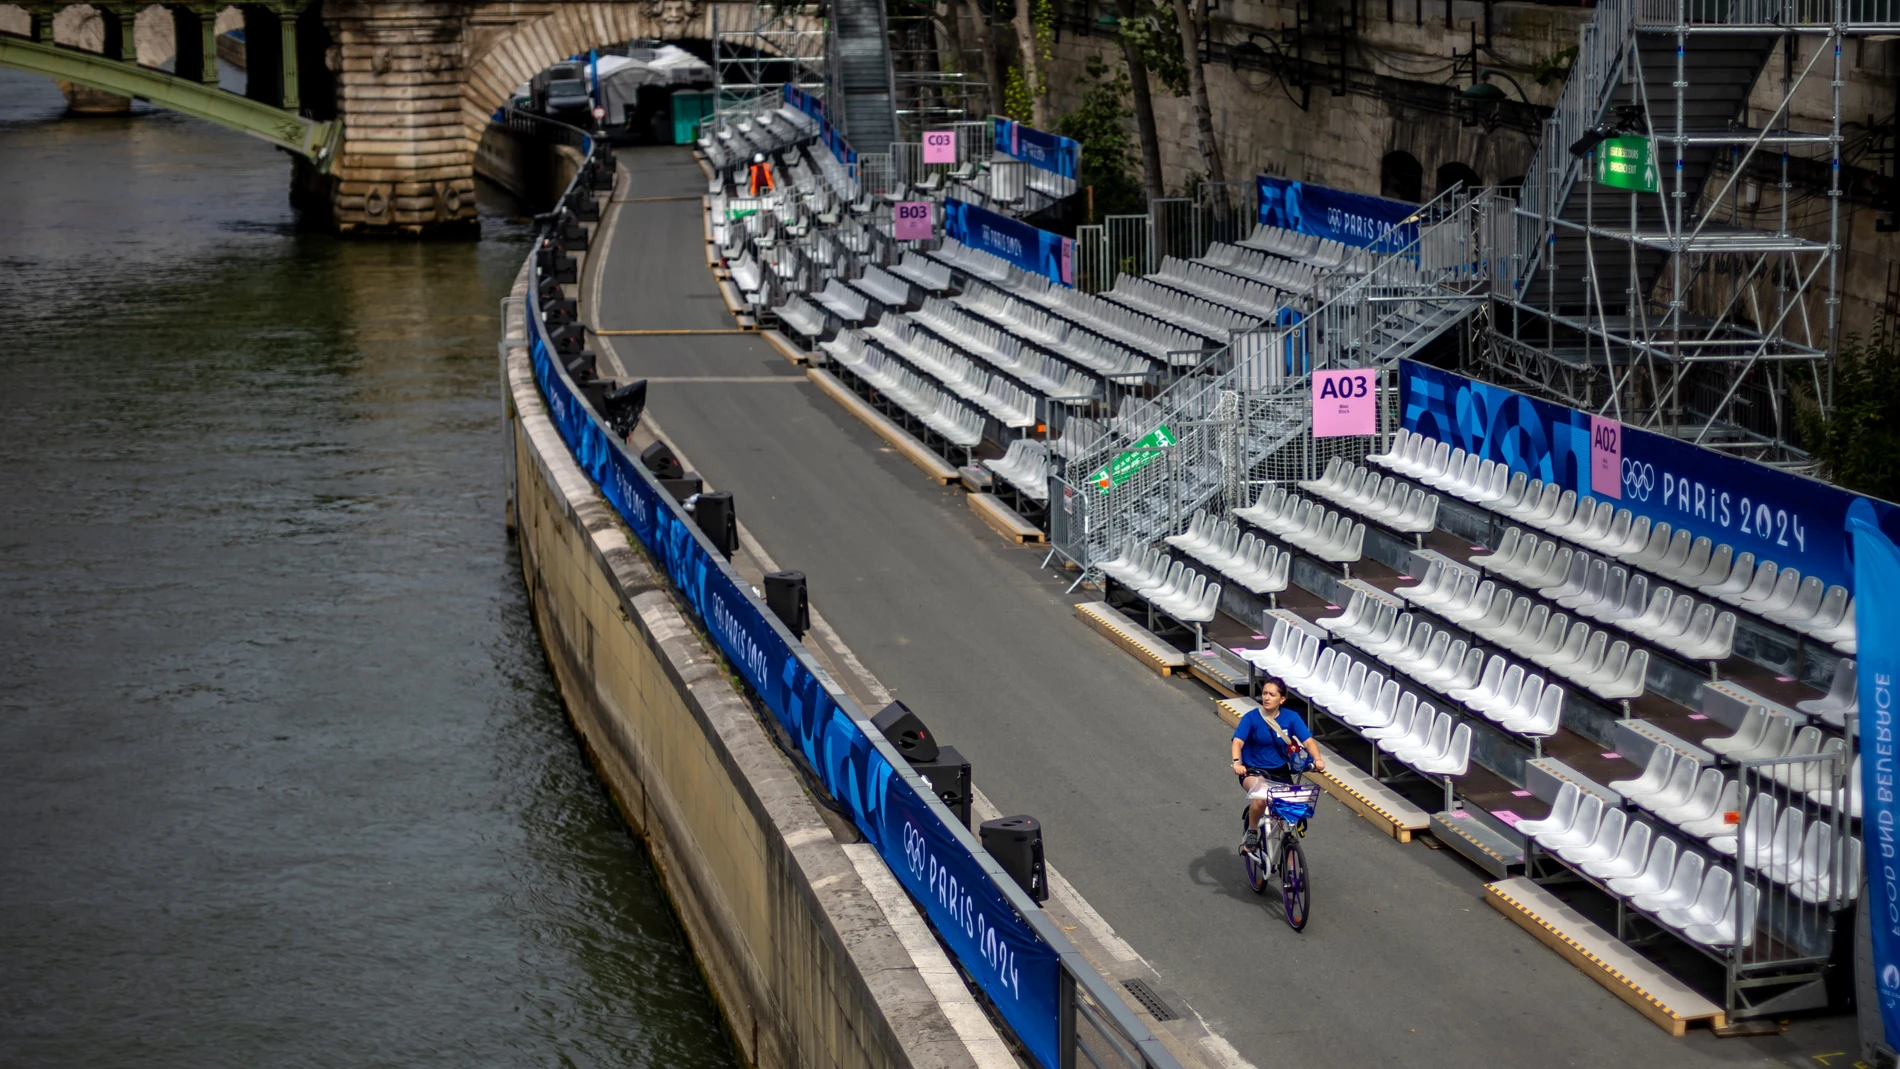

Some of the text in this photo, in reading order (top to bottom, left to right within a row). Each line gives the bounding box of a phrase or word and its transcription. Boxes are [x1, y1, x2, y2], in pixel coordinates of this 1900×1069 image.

[928, 135, 950, 146] C03
[900, 206, 927, 219] B03
[1320, 376, 1367, 399] A03
[1594, 424, 1617, 455] A02
[1740, 497, 1804, 552] 2024
[747, 637, 767, 690] 2024
[978, 913, 1018, 1000] 2024
